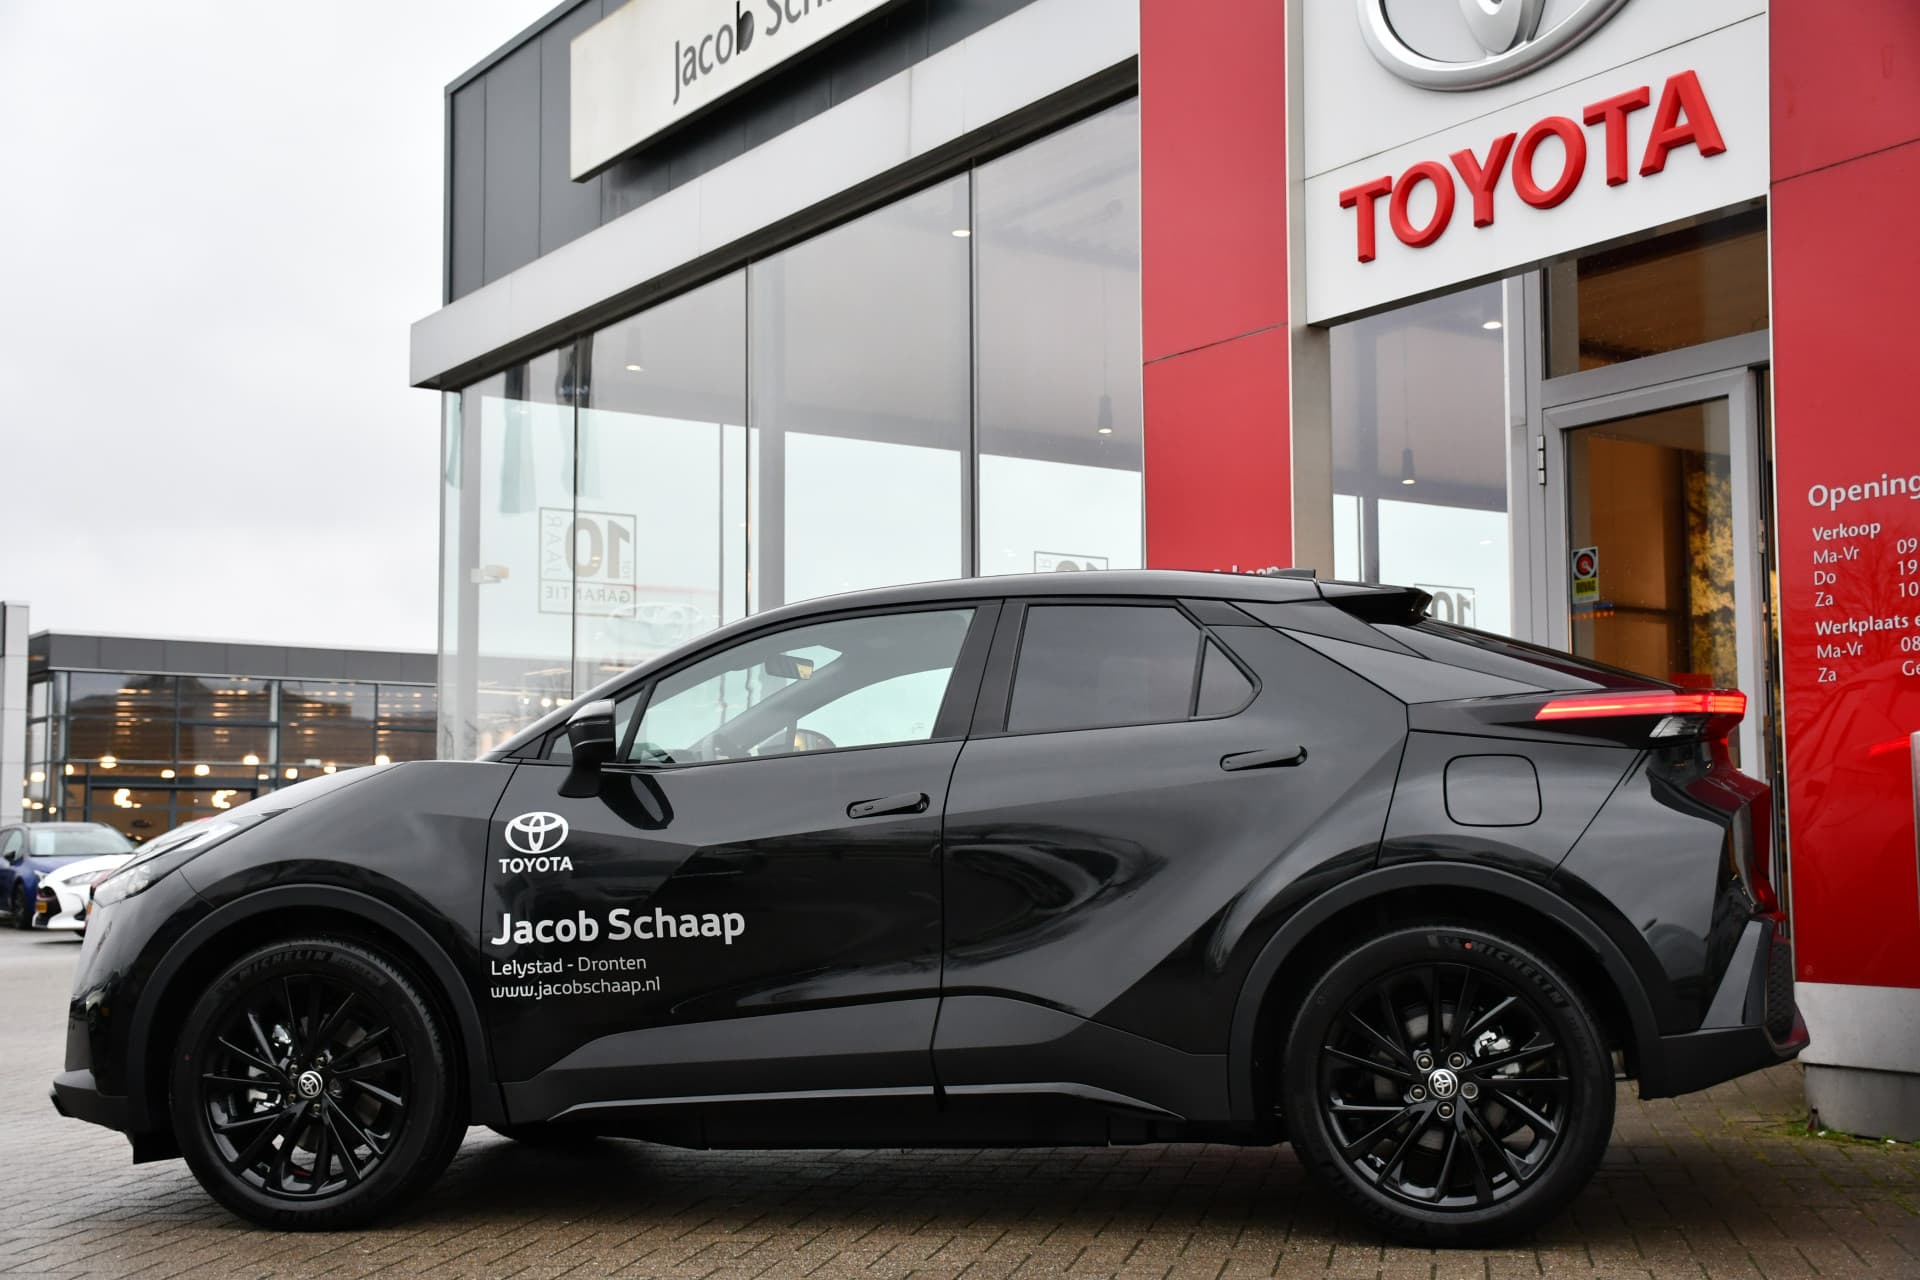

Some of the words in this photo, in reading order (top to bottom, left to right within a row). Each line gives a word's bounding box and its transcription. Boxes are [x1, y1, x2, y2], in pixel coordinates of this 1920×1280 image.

[673, 0, 755, 105] Jacob
[1339, 69, 1727, 263] TOYOTA
[1812, 522, 1881, 541] Verkoop
[1813, 546, 1860, 564] Ma-Vr
[1896, 538, 1918, 554] 09
[1814, 570, 1836, 586] Do
[1897, 559, 1918, 576] 19
[1815, 592, 1834, 607] Za
[1898, 582, 1919, 598] 10
[1815, 614, 1909, 636] Werkplaats
[1817, 641, 1863, 659] Ma-Vr
[1817, 667, 1837, 683] Za
[499, 856, 574, 874] TOYOTA
[490, 910, 599, 946] Jacob
[608, 907, 745, 945] Schaap
[491, 957, 563, 979] Lelystad
[578, 956, 647, 972] Dronten
[1471, 941, 1566, 1005] MICHELIN
[490, 976, 661, 1000] www.jacobschaap.nl
